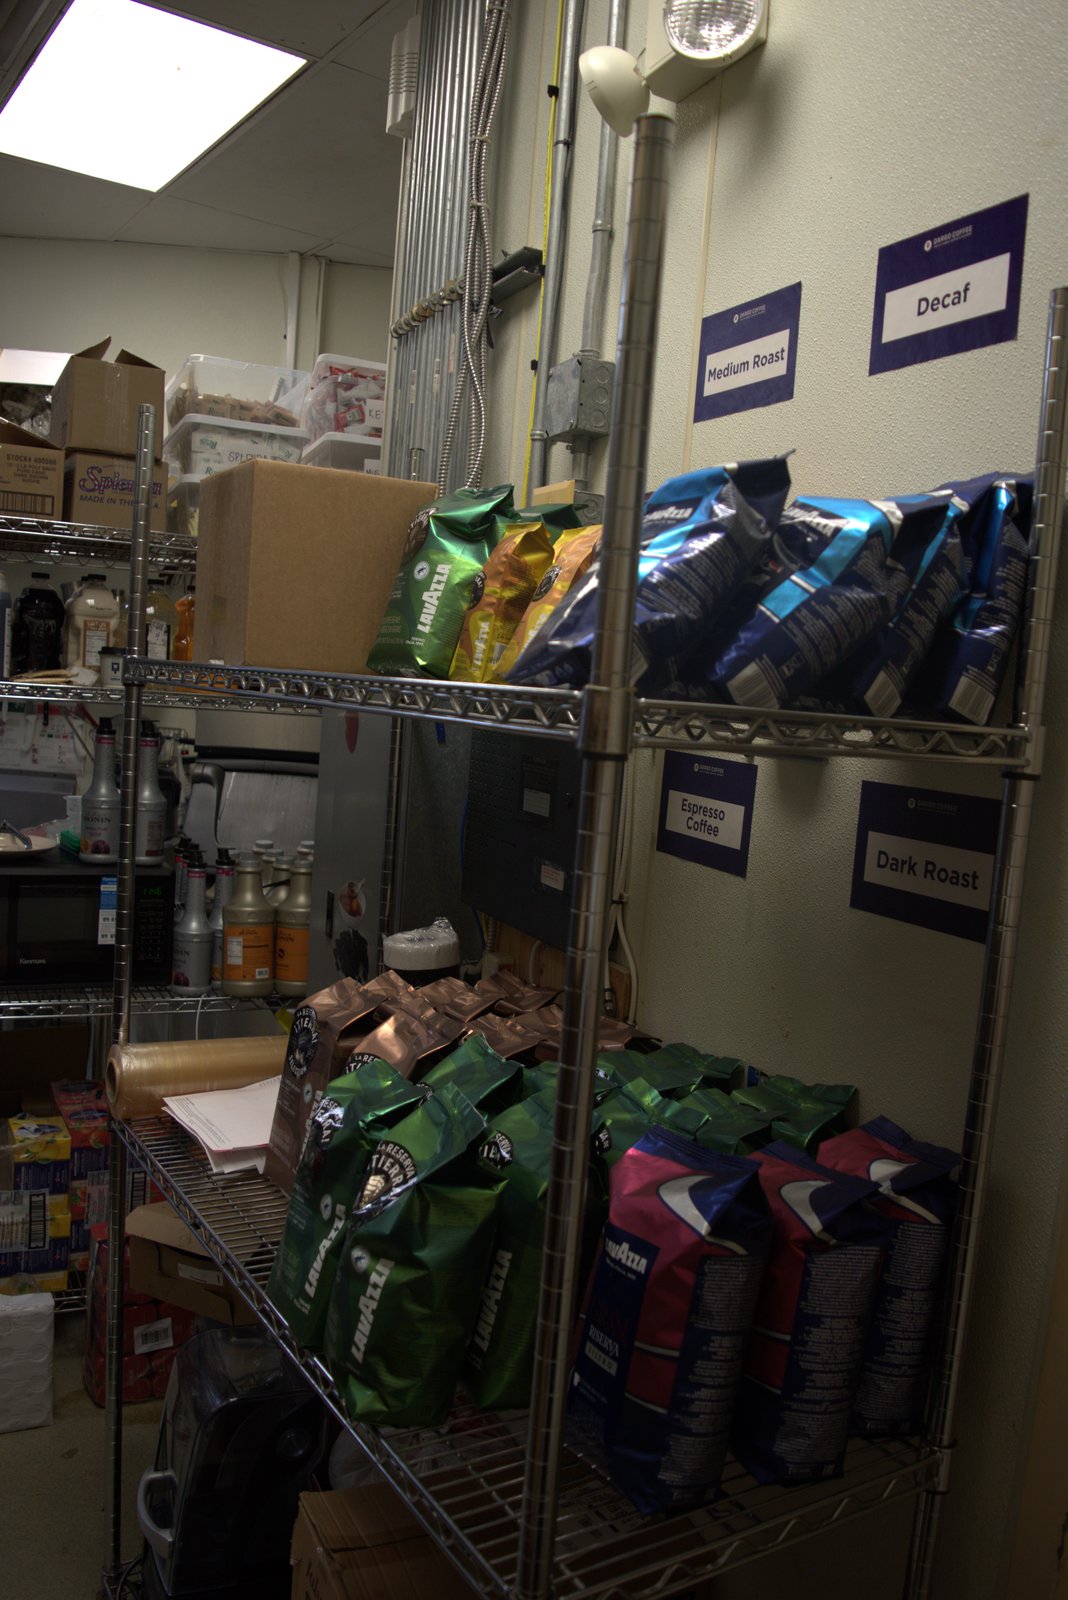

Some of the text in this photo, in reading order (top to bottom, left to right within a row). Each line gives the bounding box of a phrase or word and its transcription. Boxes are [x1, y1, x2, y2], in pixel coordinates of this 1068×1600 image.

[917, 282, 971, 317] Decaf
[708, 347, 785, 382] Medium Roast
[80, 495, 105, 504] MADE
[417, 563, 453, 634] LAVAZZA
[681, 798, 725, 821] Espresso
[686, 816, 719, 837] Coffee
[877, 850, 978, 889] Dark Roast
[377, 1143, 416, 1180] LA RESERVA
[305, 1203, 346, 1299] LAVAZZA
[351, 1257, 396, 1365] LAVAZZA
[473, 1249, 513, 1352] LAVAZZA
[589, 1323, 620, 1358] RISERVA
